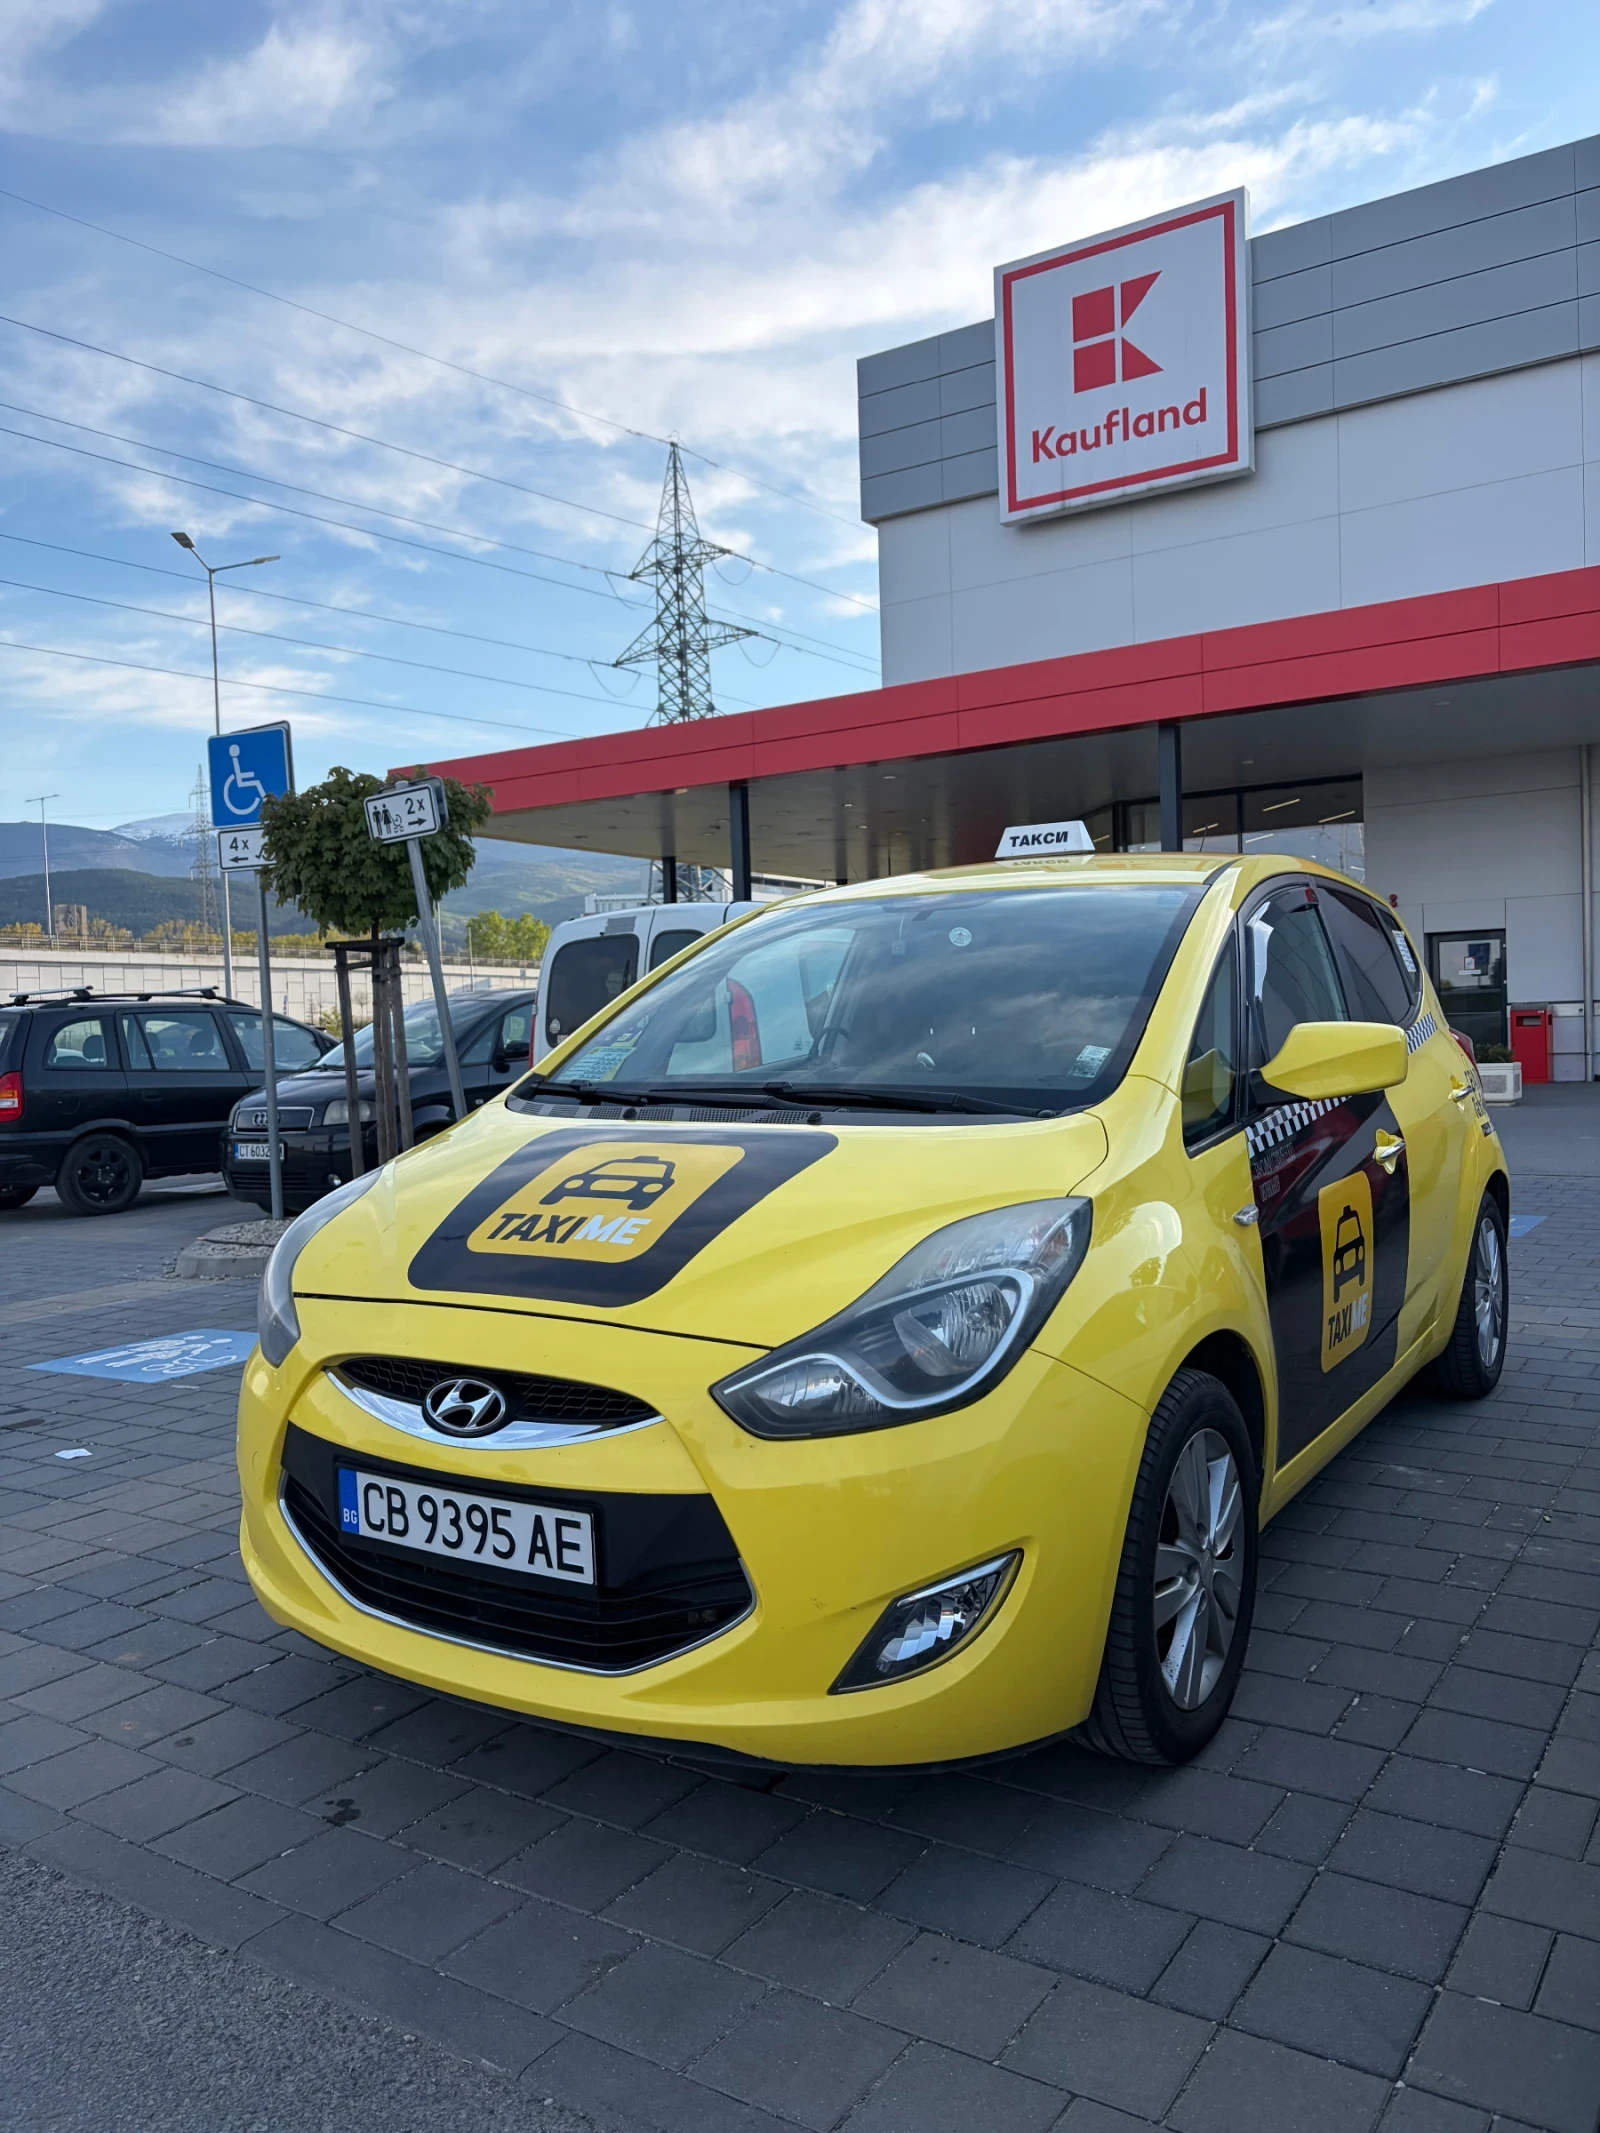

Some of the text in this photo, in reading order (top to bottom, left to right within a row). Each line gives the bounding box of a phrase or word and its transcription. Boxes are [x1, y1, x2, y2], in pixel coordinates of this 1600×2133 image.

[1032, 386, 1207, 463] Kaufland
[1009, 831, 1069, 847] ТАКСИ
[343, 1507, 358, 1524] BG
